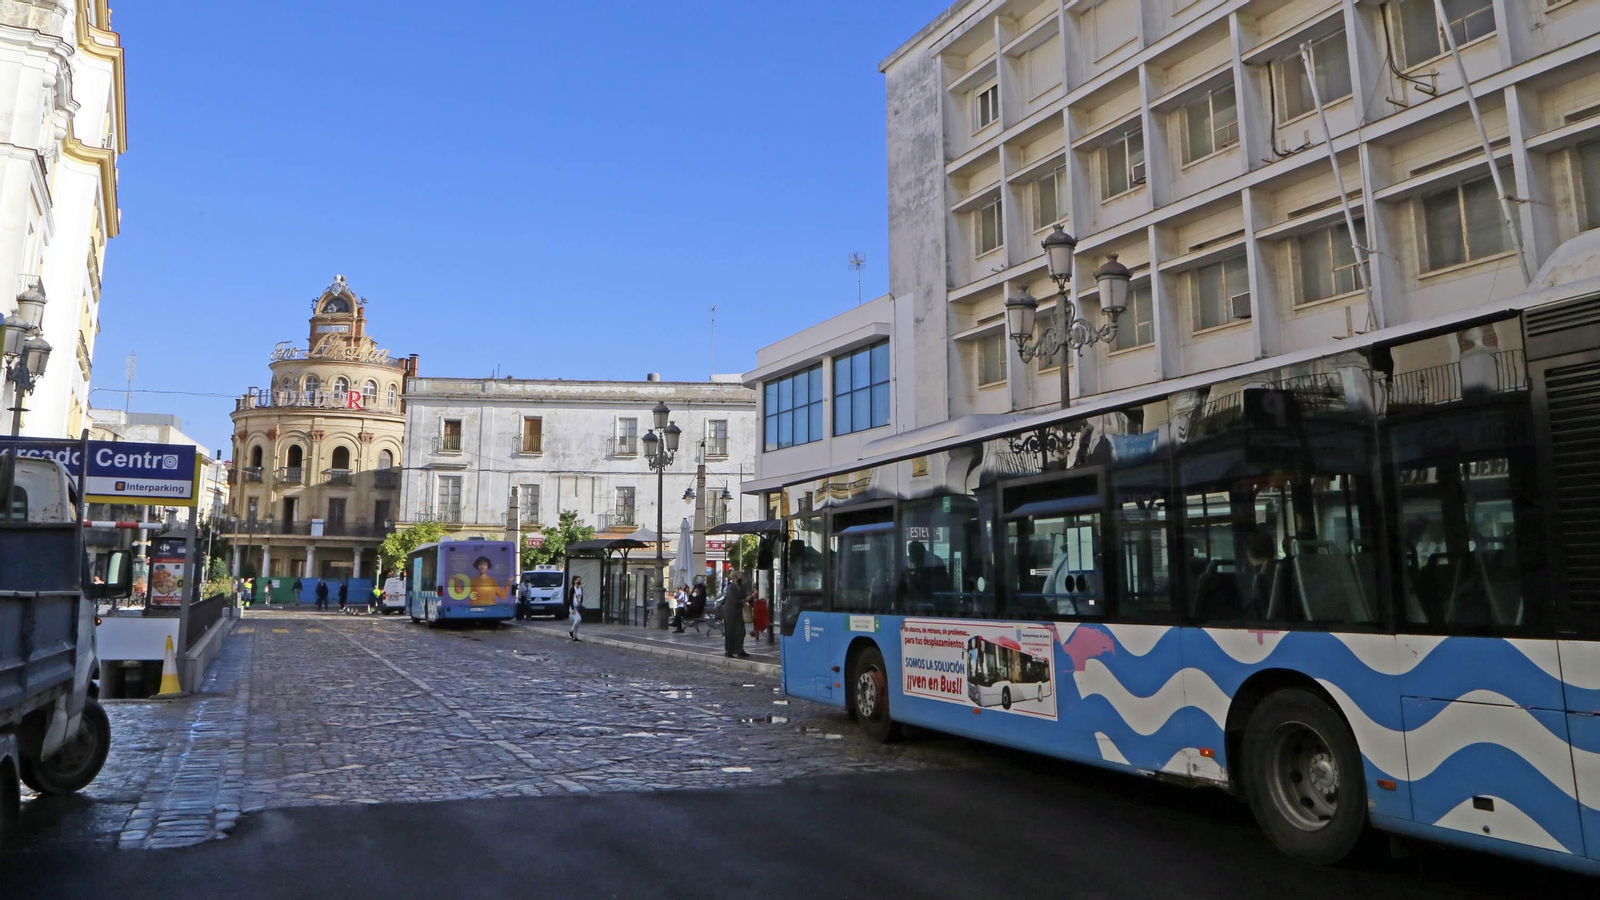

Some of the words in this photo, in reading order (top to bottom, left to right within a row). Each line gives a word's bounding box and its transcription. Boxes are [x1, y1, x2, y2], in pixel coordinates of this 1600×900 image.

[248, 386, 364, 411] FUNDADOR
[126, 482, 184, 494] Interparking
[904, 637, 915, 646] para
[915, 637, 923, 645] tus
[923, 636, 965, 648] desplazamientos
[905, 657, 926, 669] SOMOS
[926, 660, 934, 671] LA
[934, 660, 965, 675] SOLUCIÓN
[928, 677, 938, 691] en
[940, 674, 963, 695] Bus!!
